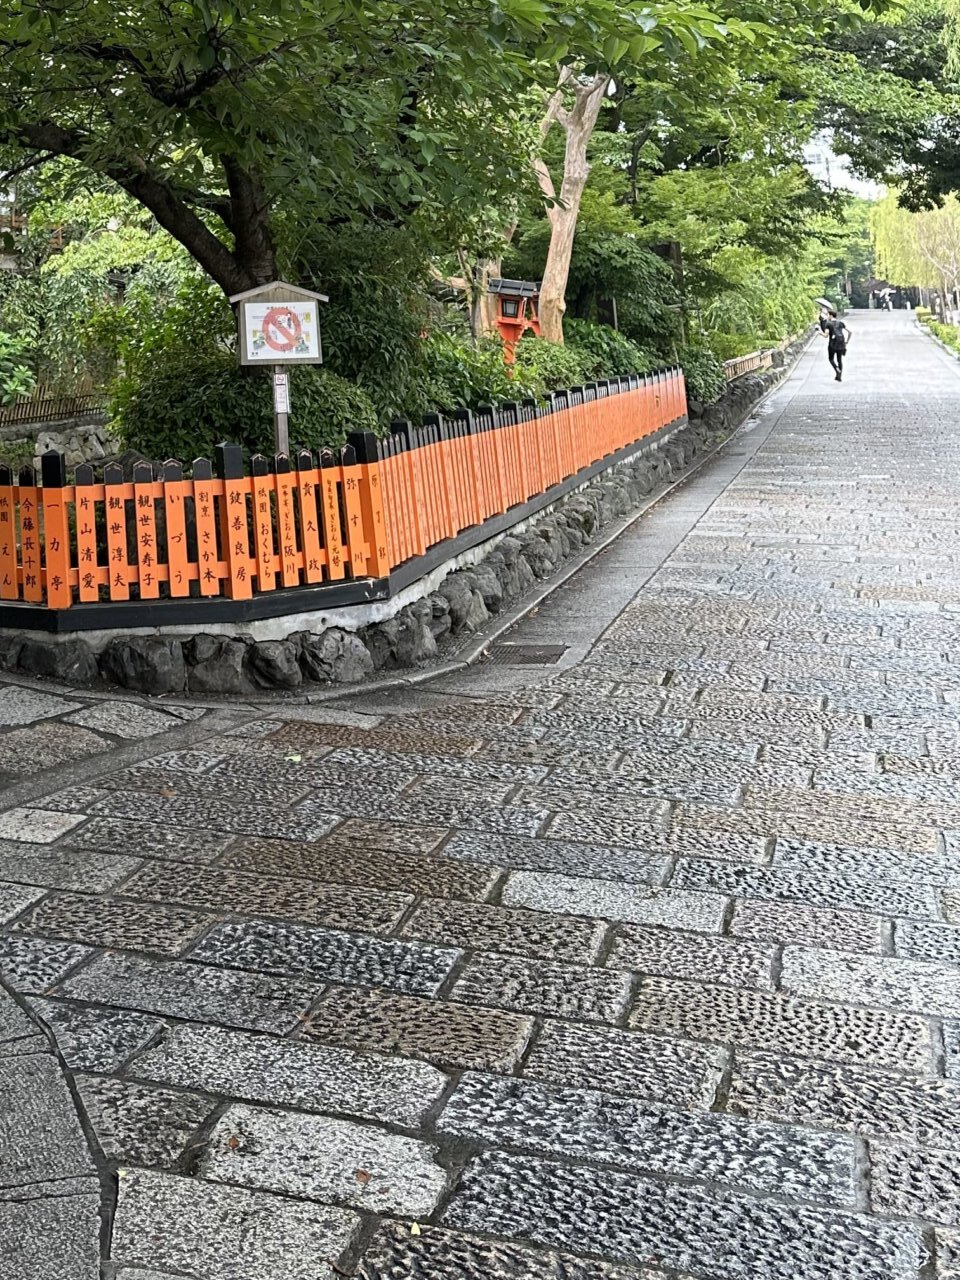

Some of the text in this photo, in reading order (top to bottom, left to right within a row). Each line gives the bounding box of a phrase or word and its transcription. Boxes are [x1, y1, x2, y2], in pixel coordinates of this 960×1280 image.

[22, 497, 37, 588] 今藤長十郎
[47, 503, 63, 591] 一力亭
[80, 497, 95, 589] 片山清愛
[108, 496, 126, 587] 観世淳夫
[137, 495, 155, 586] 観世安寿子
[169, 495, 184, 584] いづう
[229, 491, 247, 582] 鍵善良房
